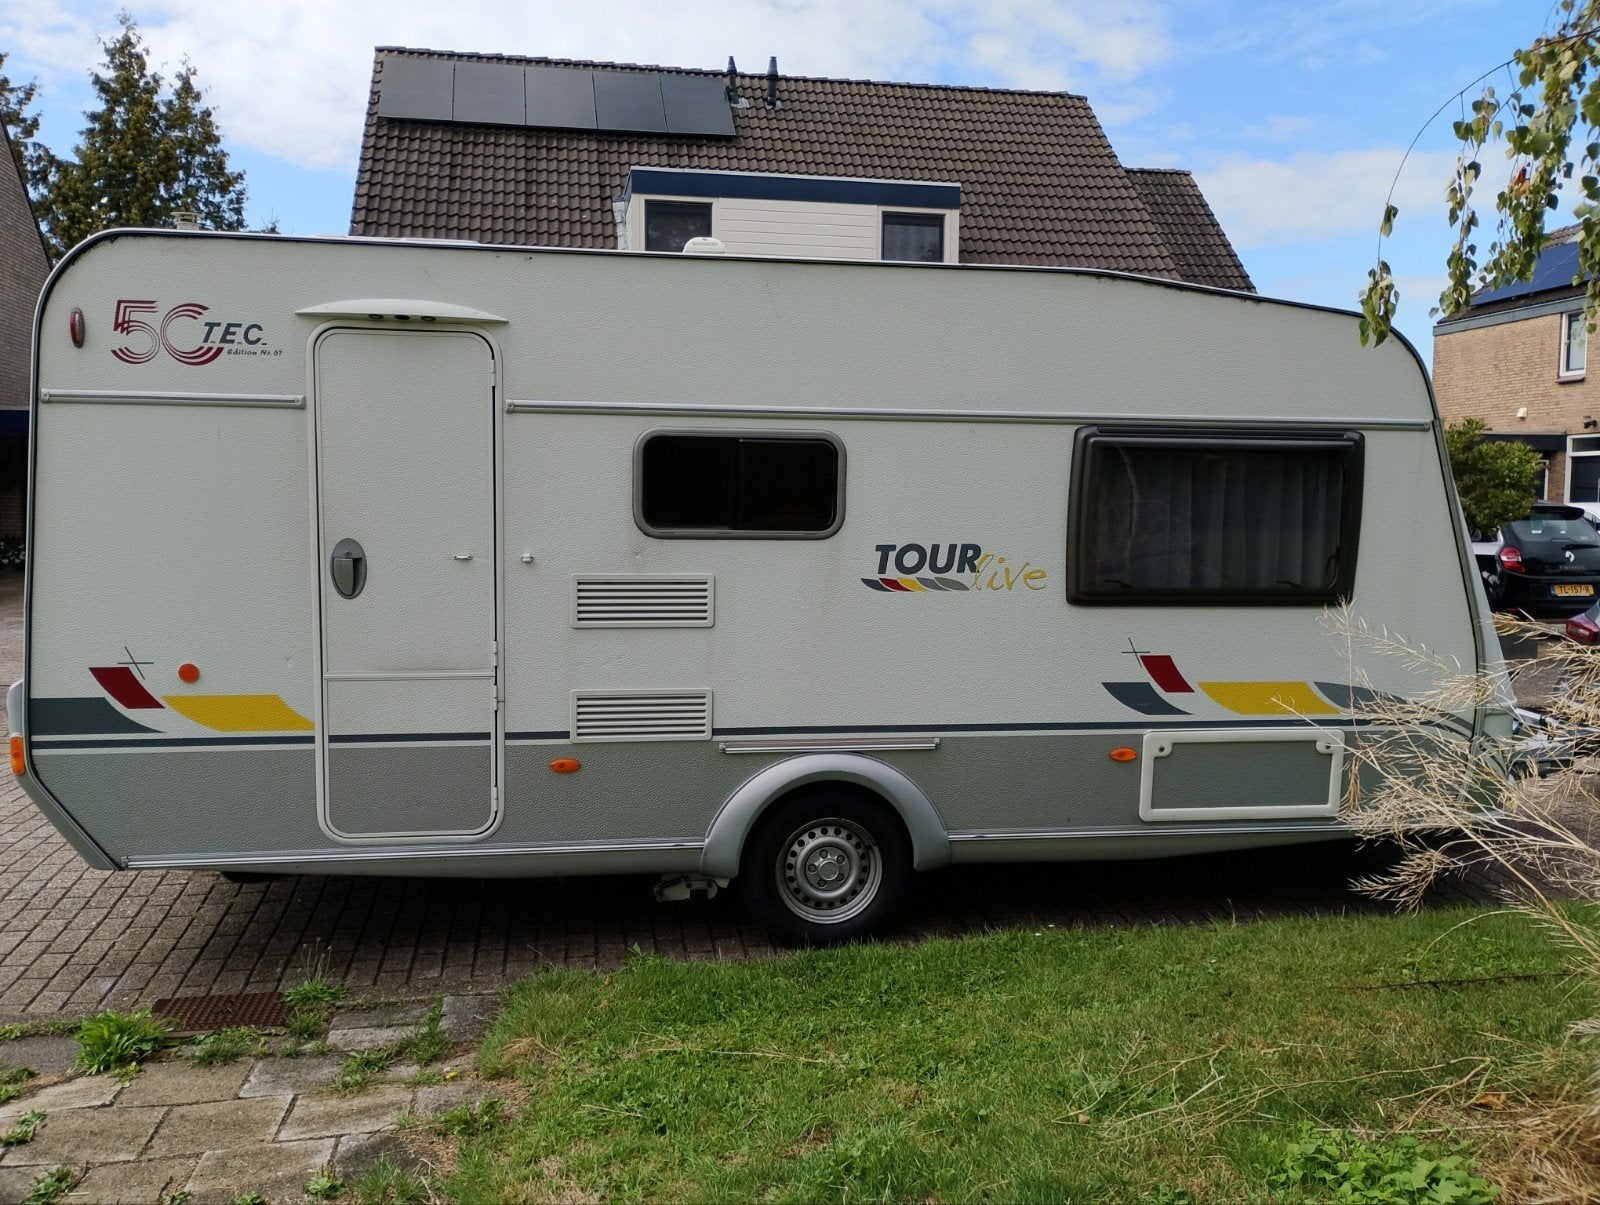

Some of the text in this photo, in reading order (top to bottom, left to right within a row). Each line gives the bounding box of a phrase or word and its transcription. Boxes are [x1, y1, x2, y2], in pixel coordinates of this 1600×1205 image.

[227, 348, 257, 356] Edition
[876, 544, 1048, 591] TOUR live
[1559, 585, 1591, 594] TL-157-R
